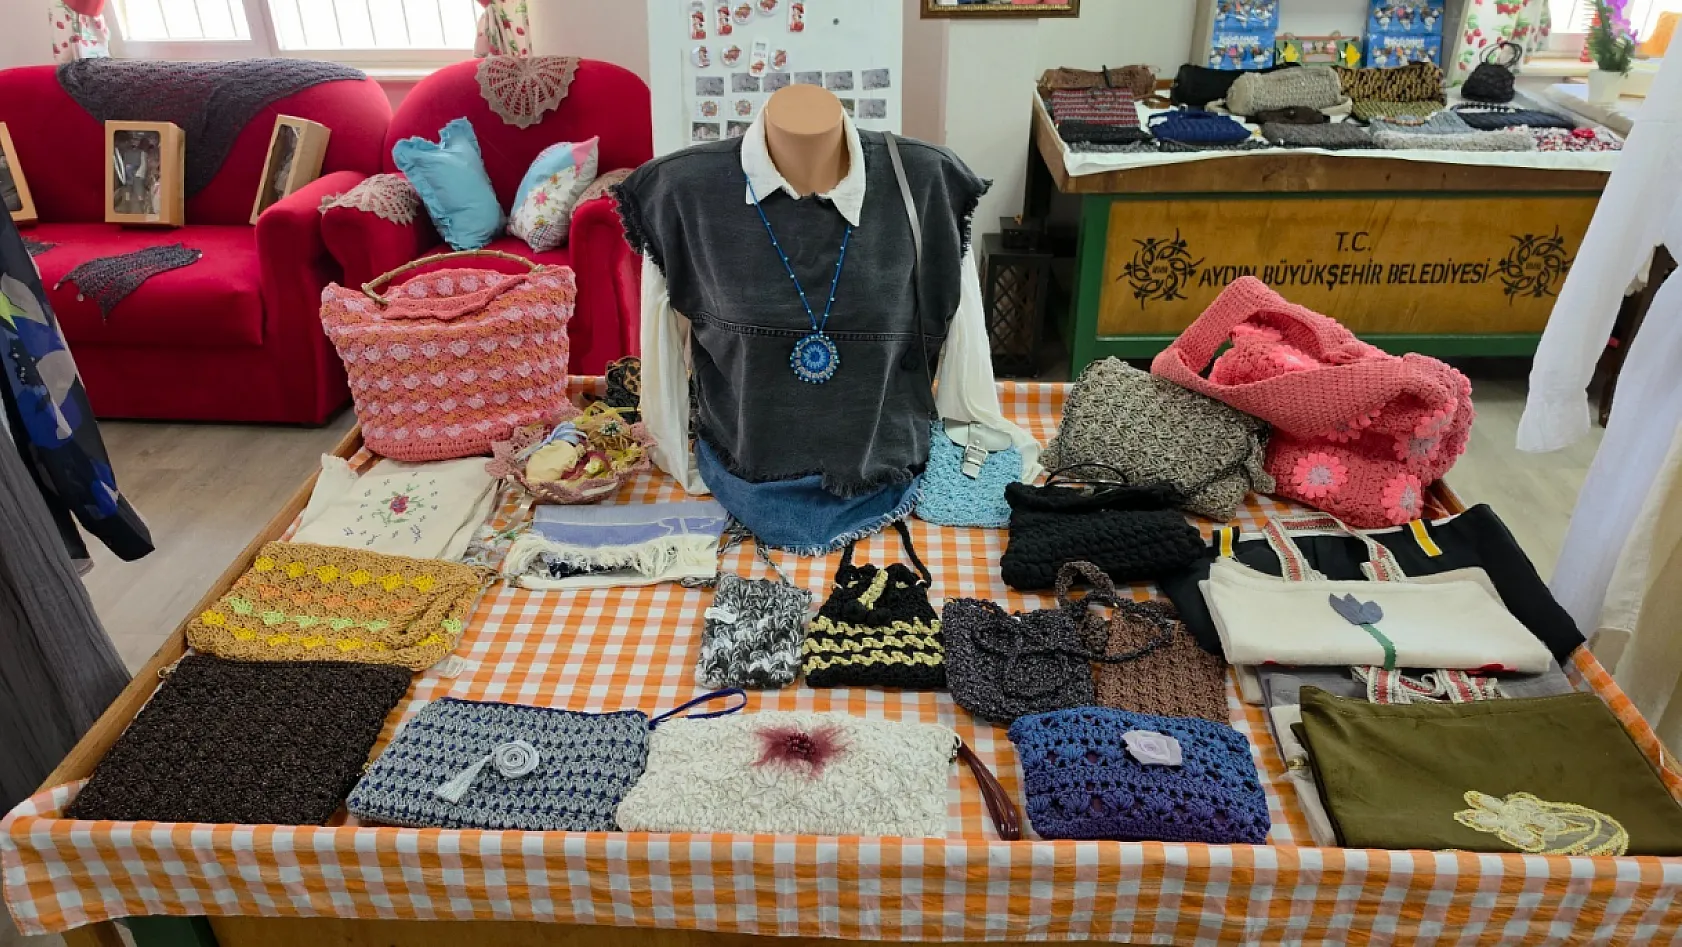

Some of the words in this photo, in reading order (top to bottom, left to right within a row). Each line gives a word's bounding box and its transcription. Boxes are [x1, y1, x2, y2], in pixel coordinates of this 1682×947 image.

[1336, 231, 1371, 252] T.C.
[1262, 258, 1383, 291] BÜYÜKŞEHİR
[1387, 258, 1491, 284] BELEDİYESİ
